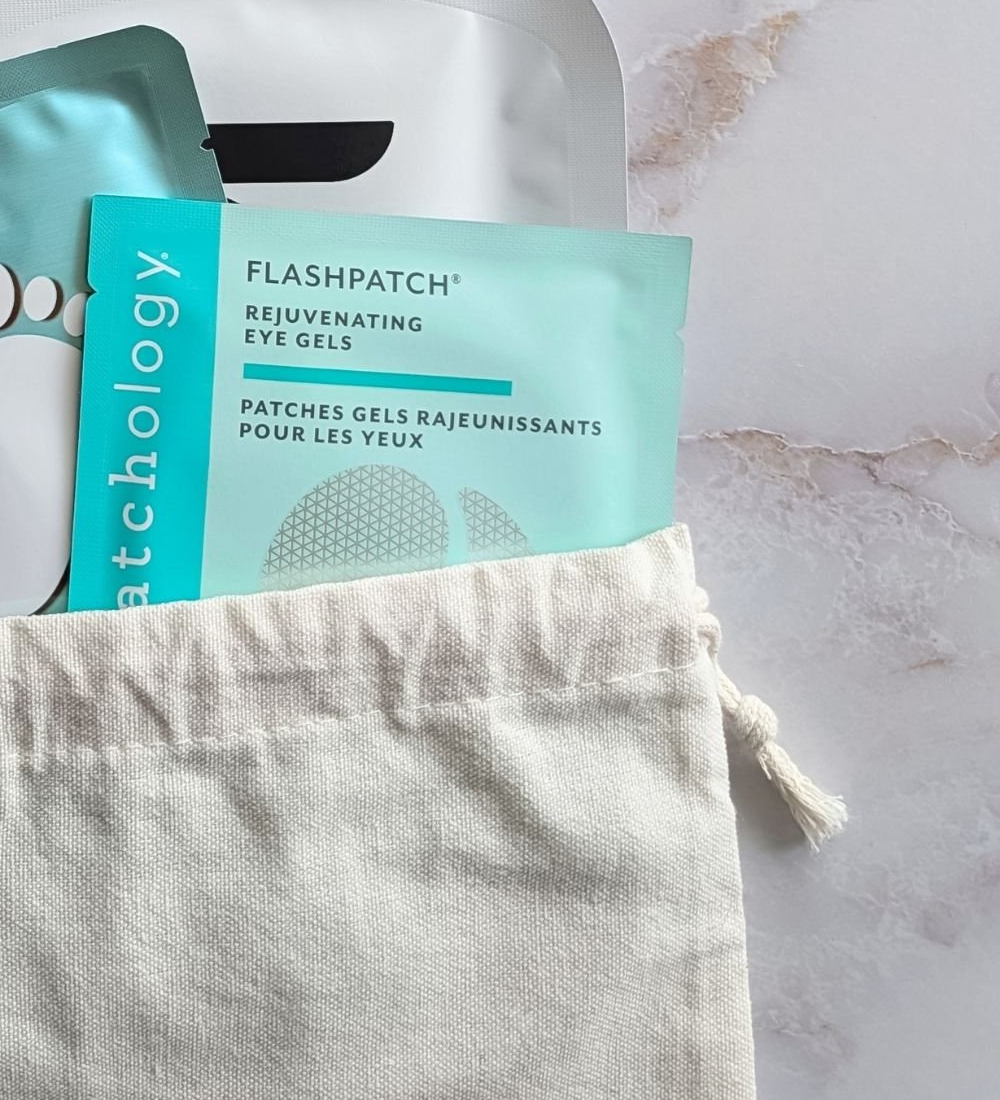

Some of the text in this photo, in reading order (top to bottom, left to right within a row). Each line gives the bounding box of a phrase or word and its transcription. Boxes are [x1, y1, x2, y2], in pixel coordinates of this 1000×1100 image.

[245, 304, 423, 333] REJUVENATING
[244, 328, 353, 352] EYE GELS
[240, 398, 603, 438] PATCHES GELS RAJEUNISSANTS
[239, 422, 424, 450] POUR LES YEUX
